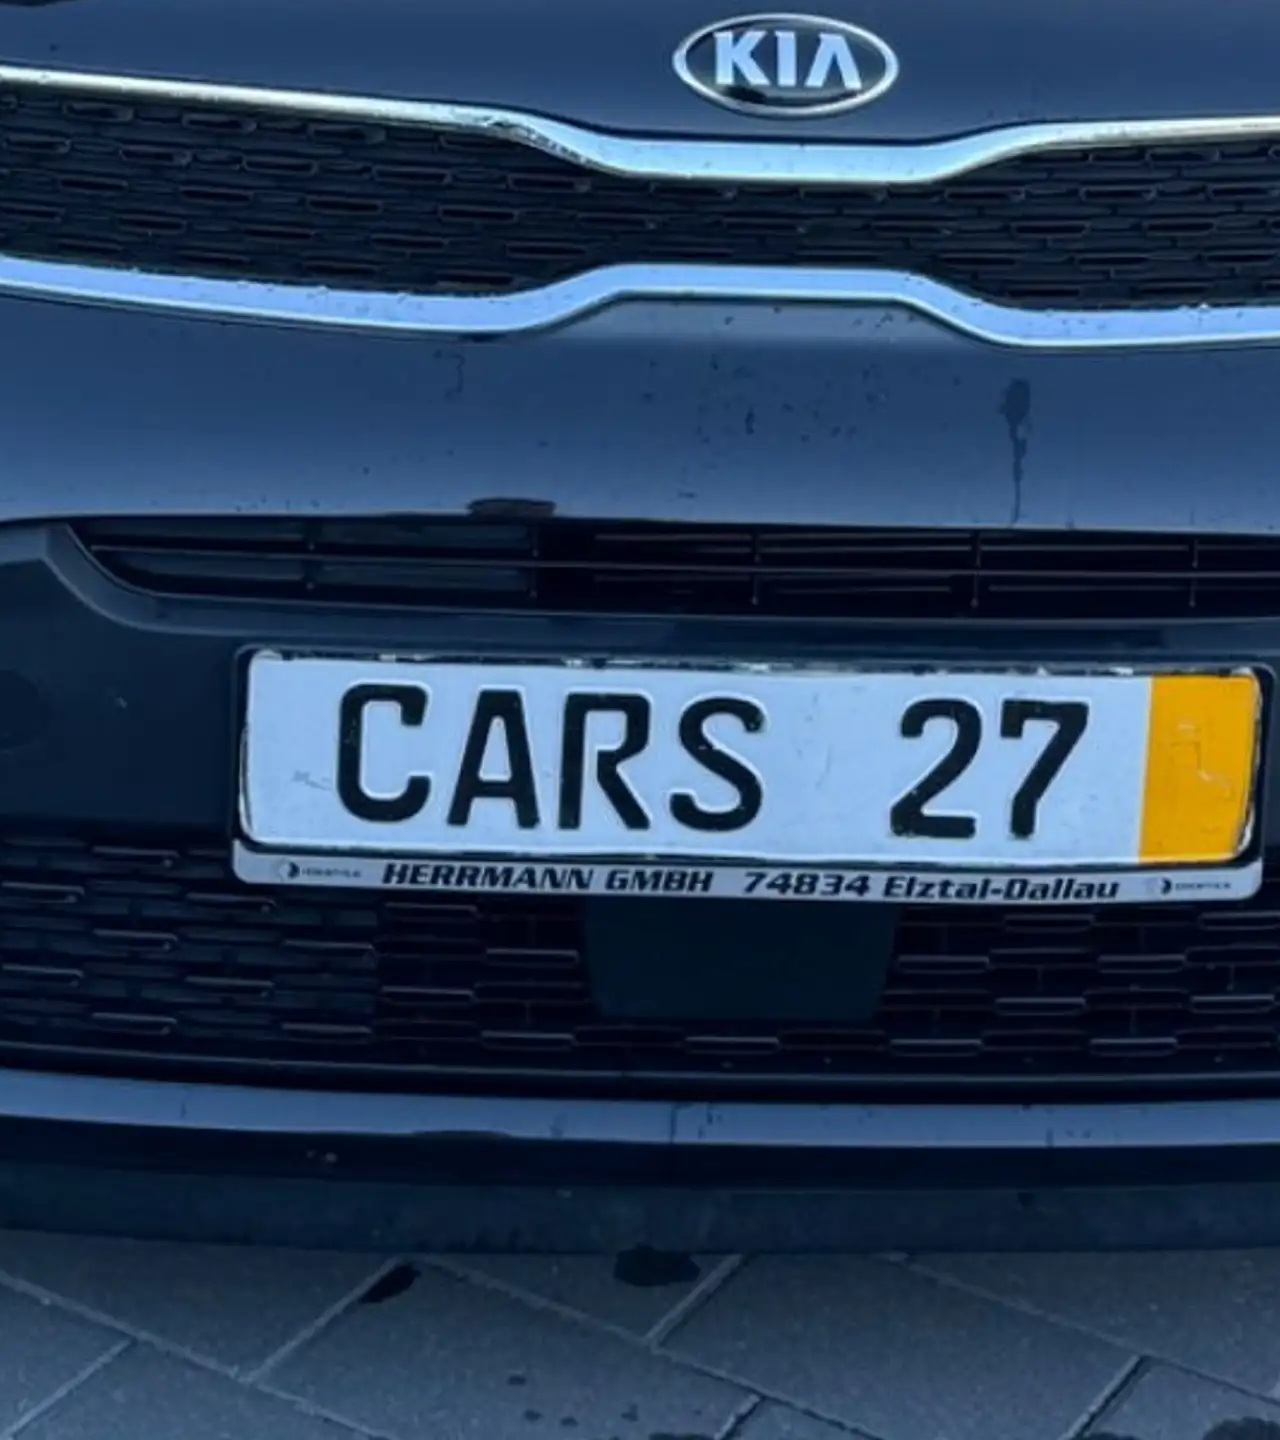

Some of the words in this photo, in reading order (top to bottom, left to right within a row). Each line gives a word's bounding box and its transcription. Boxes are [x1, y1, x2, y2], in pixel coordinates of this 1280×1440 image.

[713, 30, 863, 90] KIA
[336, 682, 765, 832] CARS
[889, 697, 1090, 839] 27
[382, 862, 594, 891] HERRMANN
[605, 867, 715, 893] GMBH
[743, 870, 871, 897] 74834
[882, 874, 1121, 901] Elztal-Dallau
